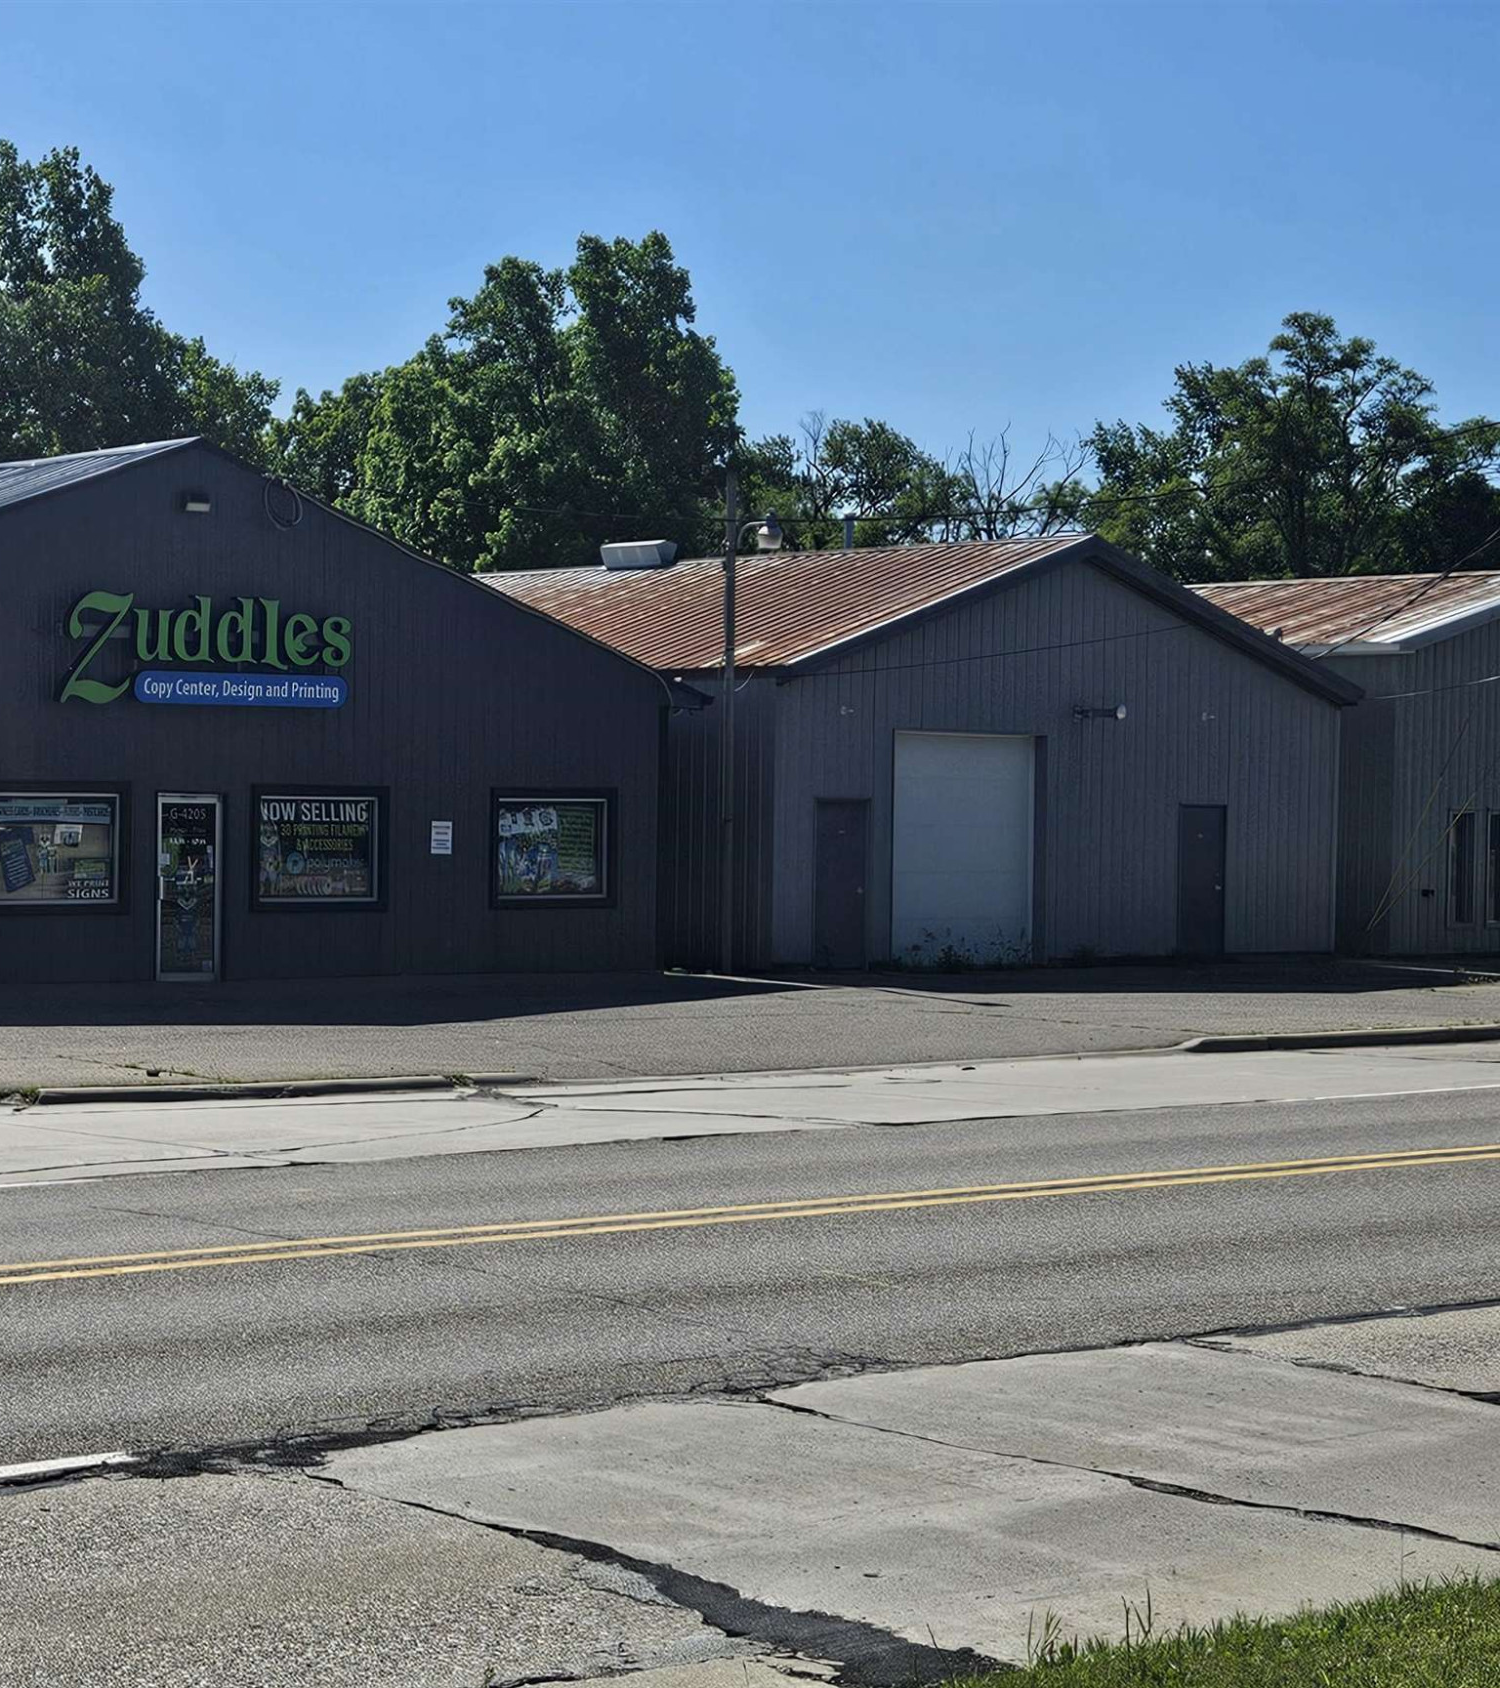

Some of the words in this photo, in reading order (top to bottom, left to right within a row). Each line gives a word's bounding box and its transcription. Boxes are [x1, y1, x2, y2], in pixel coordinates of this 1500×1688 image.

[60, 591, 352, 704] Zuddles
[143, 677, 173, 699] Copy
[175, 679, 219, 698] Center,
[222, 680, 263, 701] Design
[265, 681, 288, 698] and
[291, 682, 340, 703] Printing
[301, 802, 366, 821] SELLING
[67, 889, 109, 899] SIGNS
